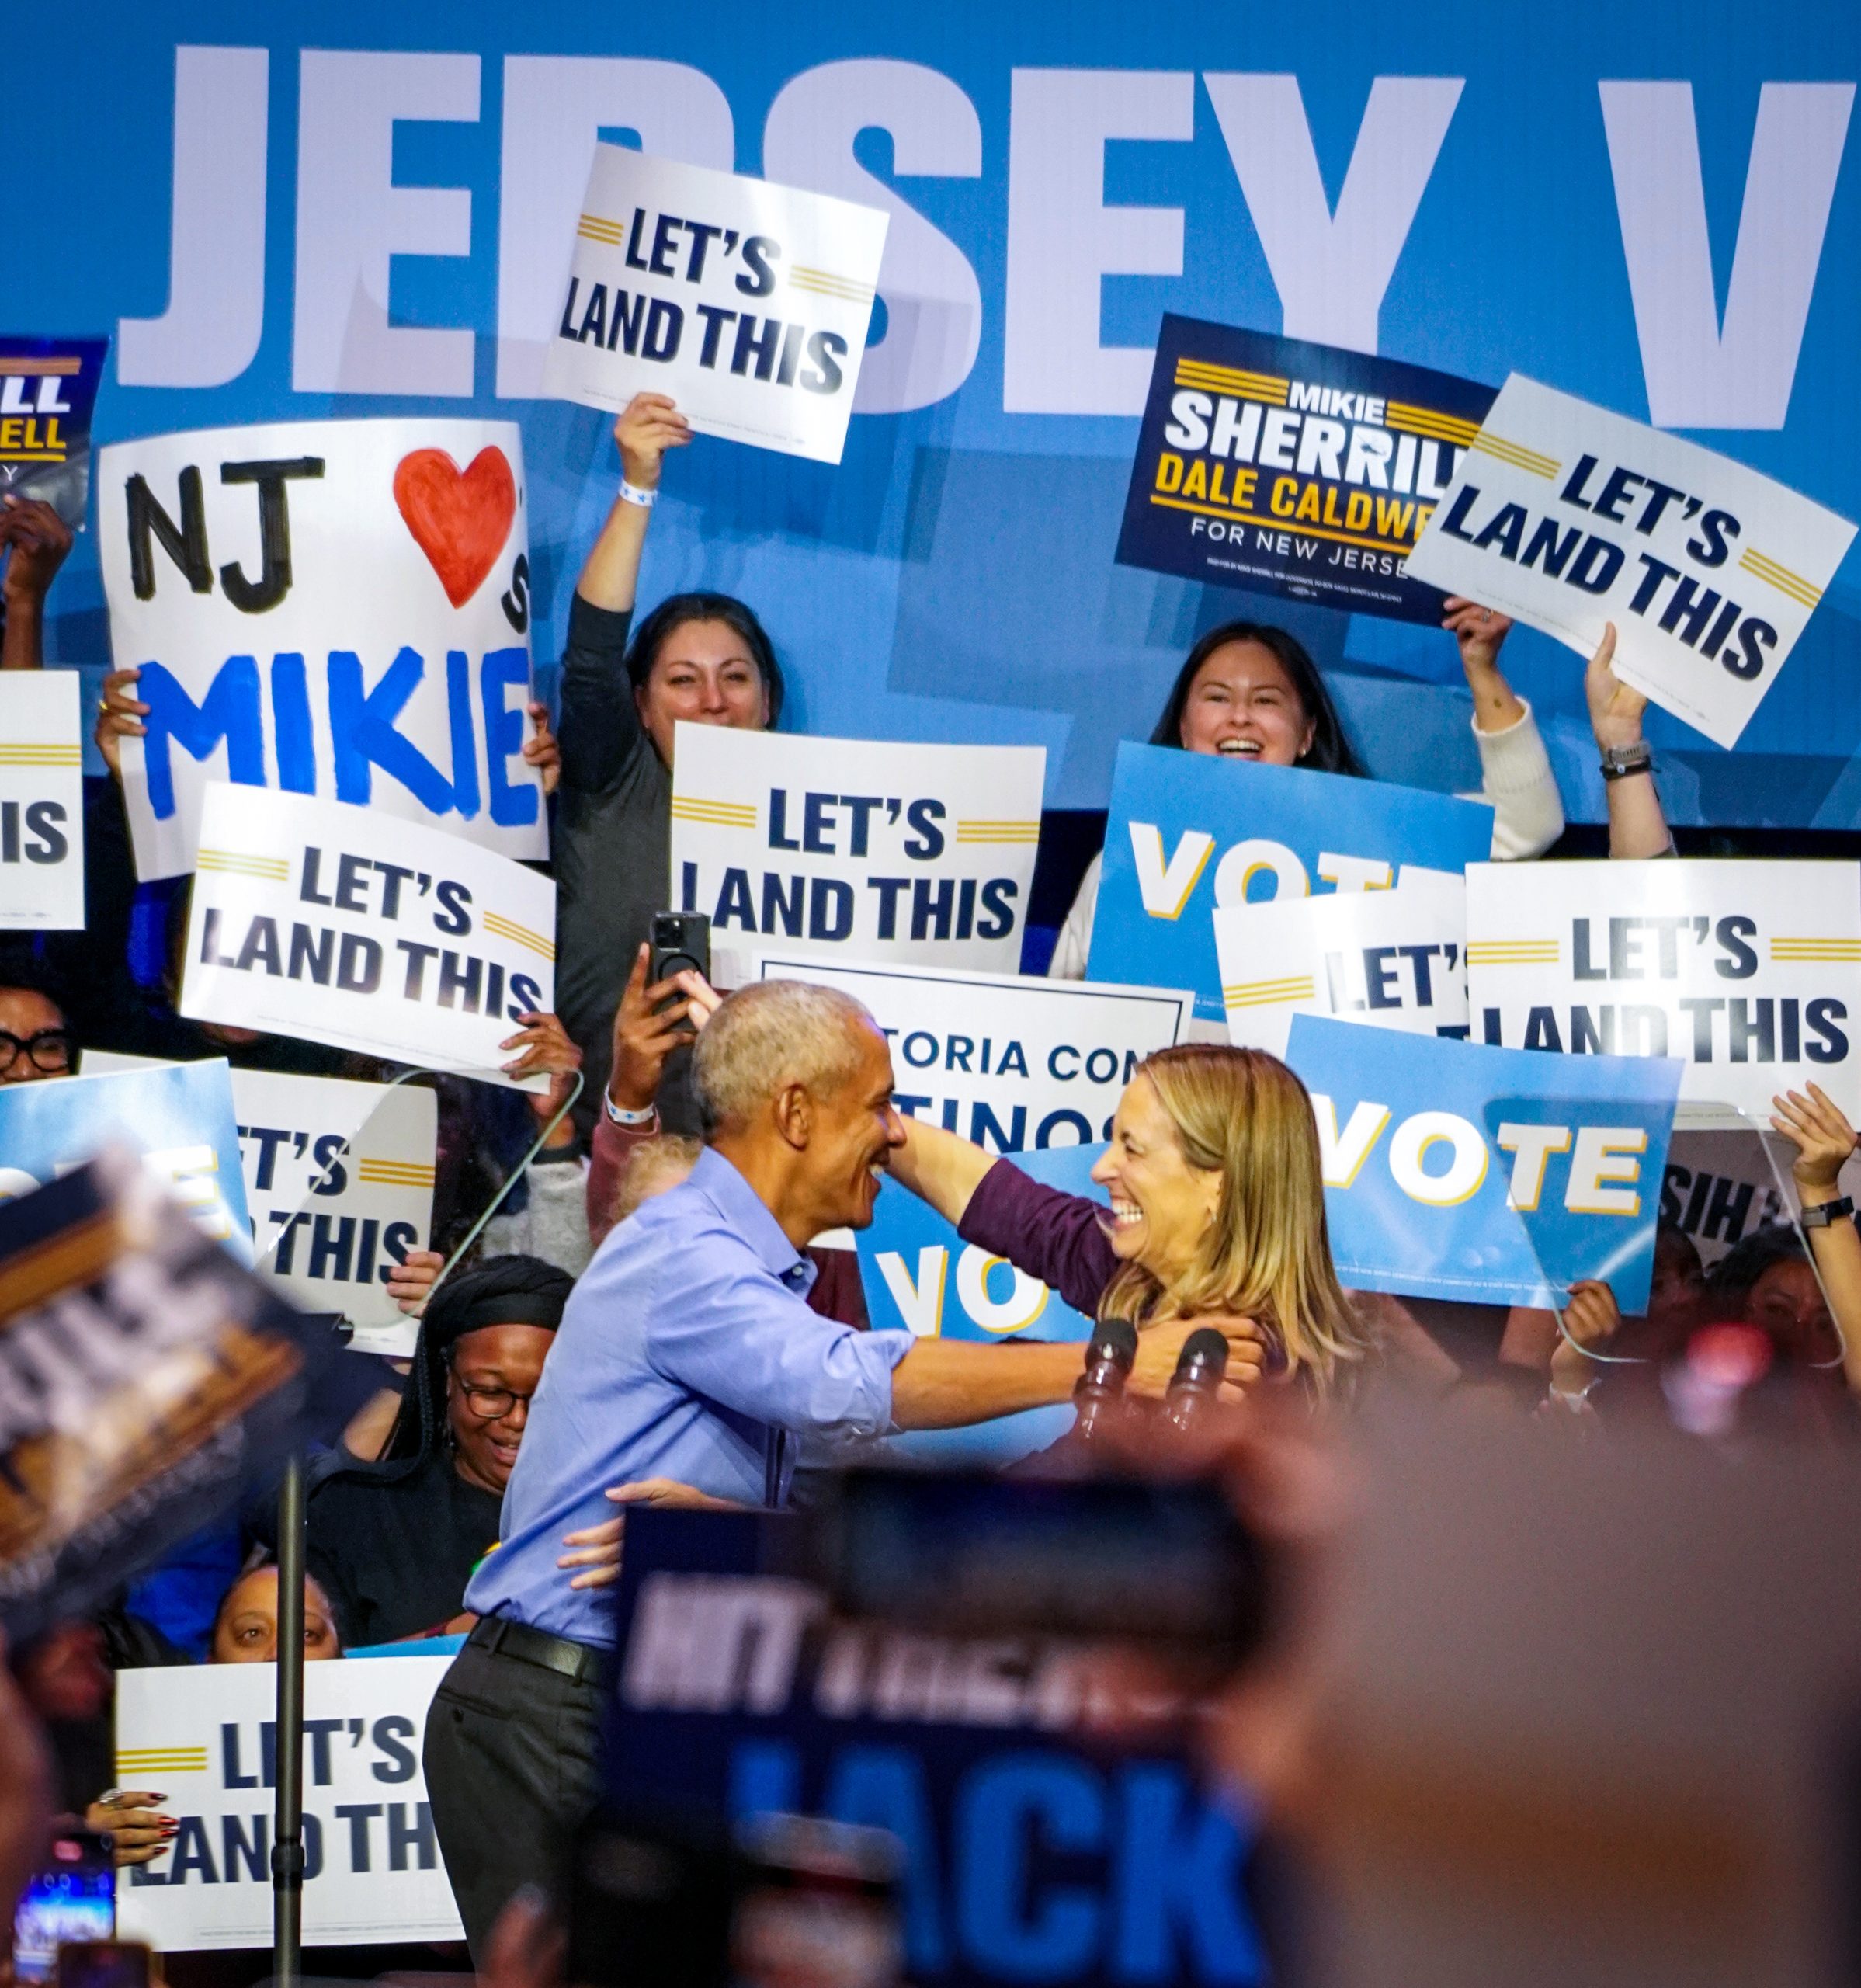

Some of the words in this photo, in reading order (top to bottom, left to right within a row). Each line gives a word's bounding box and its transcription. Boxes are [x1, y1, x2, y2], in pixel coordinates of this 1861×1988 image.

[116, 44, 1466, 416] JERSEY
[1597, 80, 1857, 432] V
[625, 207, 781, 298] LET'S
[559, 277, 685, 364] LAND
[696, 303, 848, 395] THIS
[1288, 381, 1387, 426] MIKIE
[1154, 452, 1259, 509] DALE
[1559, 452, 1741, 569] LET'S
[125, 456, 325, 614] NJ
[1191, 516, 1245, 547] FOR
[1255, 530, 1319, 561] NEW
[1439, 484, 1626, 595] LAND
[1628, 551, 1779, 682] THIS
[136, 646, 539, 826] MIKIE
[768, 788, 946, 860] LET'S
[300, 846, 473, 937] LET'S
[867, 877, 1019, 941] THIS
[1128, 821, 1464, 920] VOT
[200, 908, 384, 996] LAND
[396, 939, 543, 1024] THIS
[1325, 943, 1470, 1014] LET'
[1573, 916, 1759, 982] LET'S
[1679, 997, 1849, 1064] THIS
[1312, 1093, 1648, 1217] VOTE
[269, 1211, 418, 1284] THIS
[335, 1802, 448, 1873] TH
